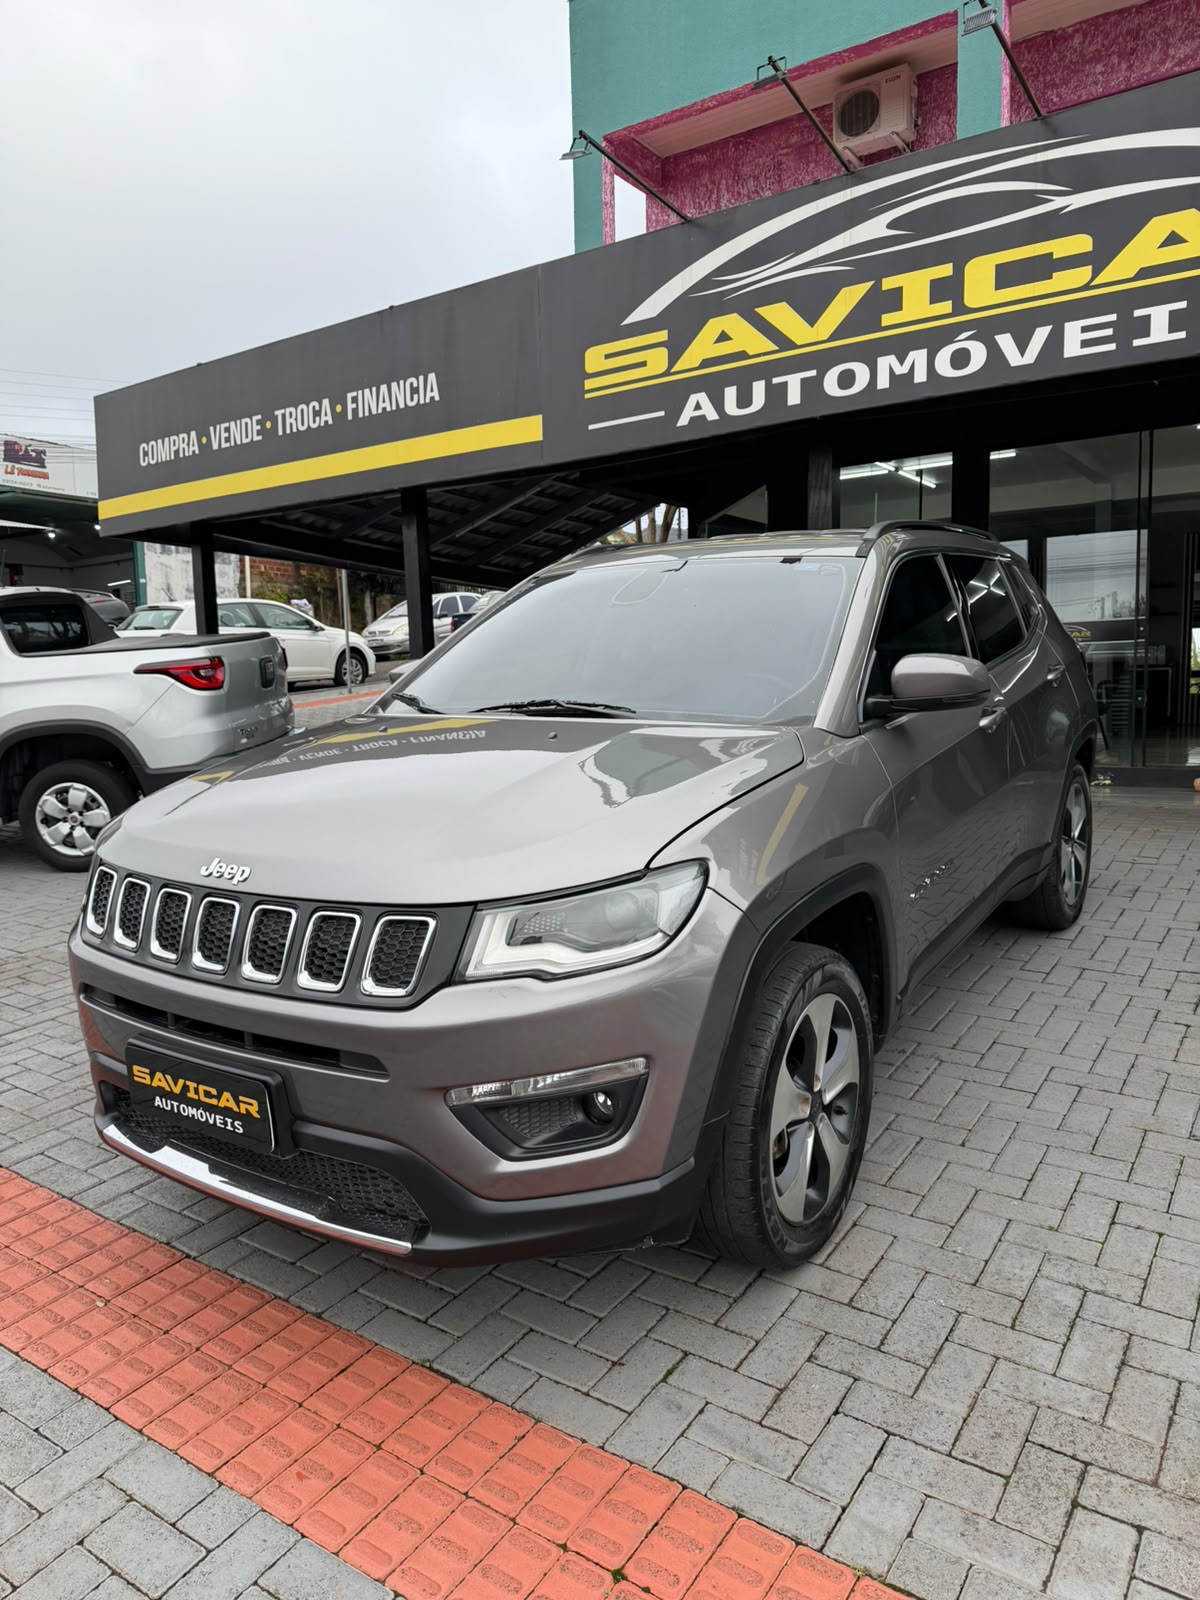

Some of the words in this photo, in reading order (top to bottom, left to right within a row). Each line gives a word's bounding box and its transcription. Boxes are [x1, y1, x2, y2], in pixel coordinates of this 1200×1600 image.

[584, 207, 1200, 391] SAVICA
[676, 300, 1188, 427] AUTOMÓVEI
[139, 430, 199, 467] COMPRA
[209, 414, 263, 450] VENDE
[274, 398, 333, 436] TROCA
[346, 372, 440, 420] FINANCIA
[200, 857, 251, 886] Jeep
[132, 1065, 261, 1118] SAVICAR
[154, 1096, 244, 1134] AUTOMÓVEIS
